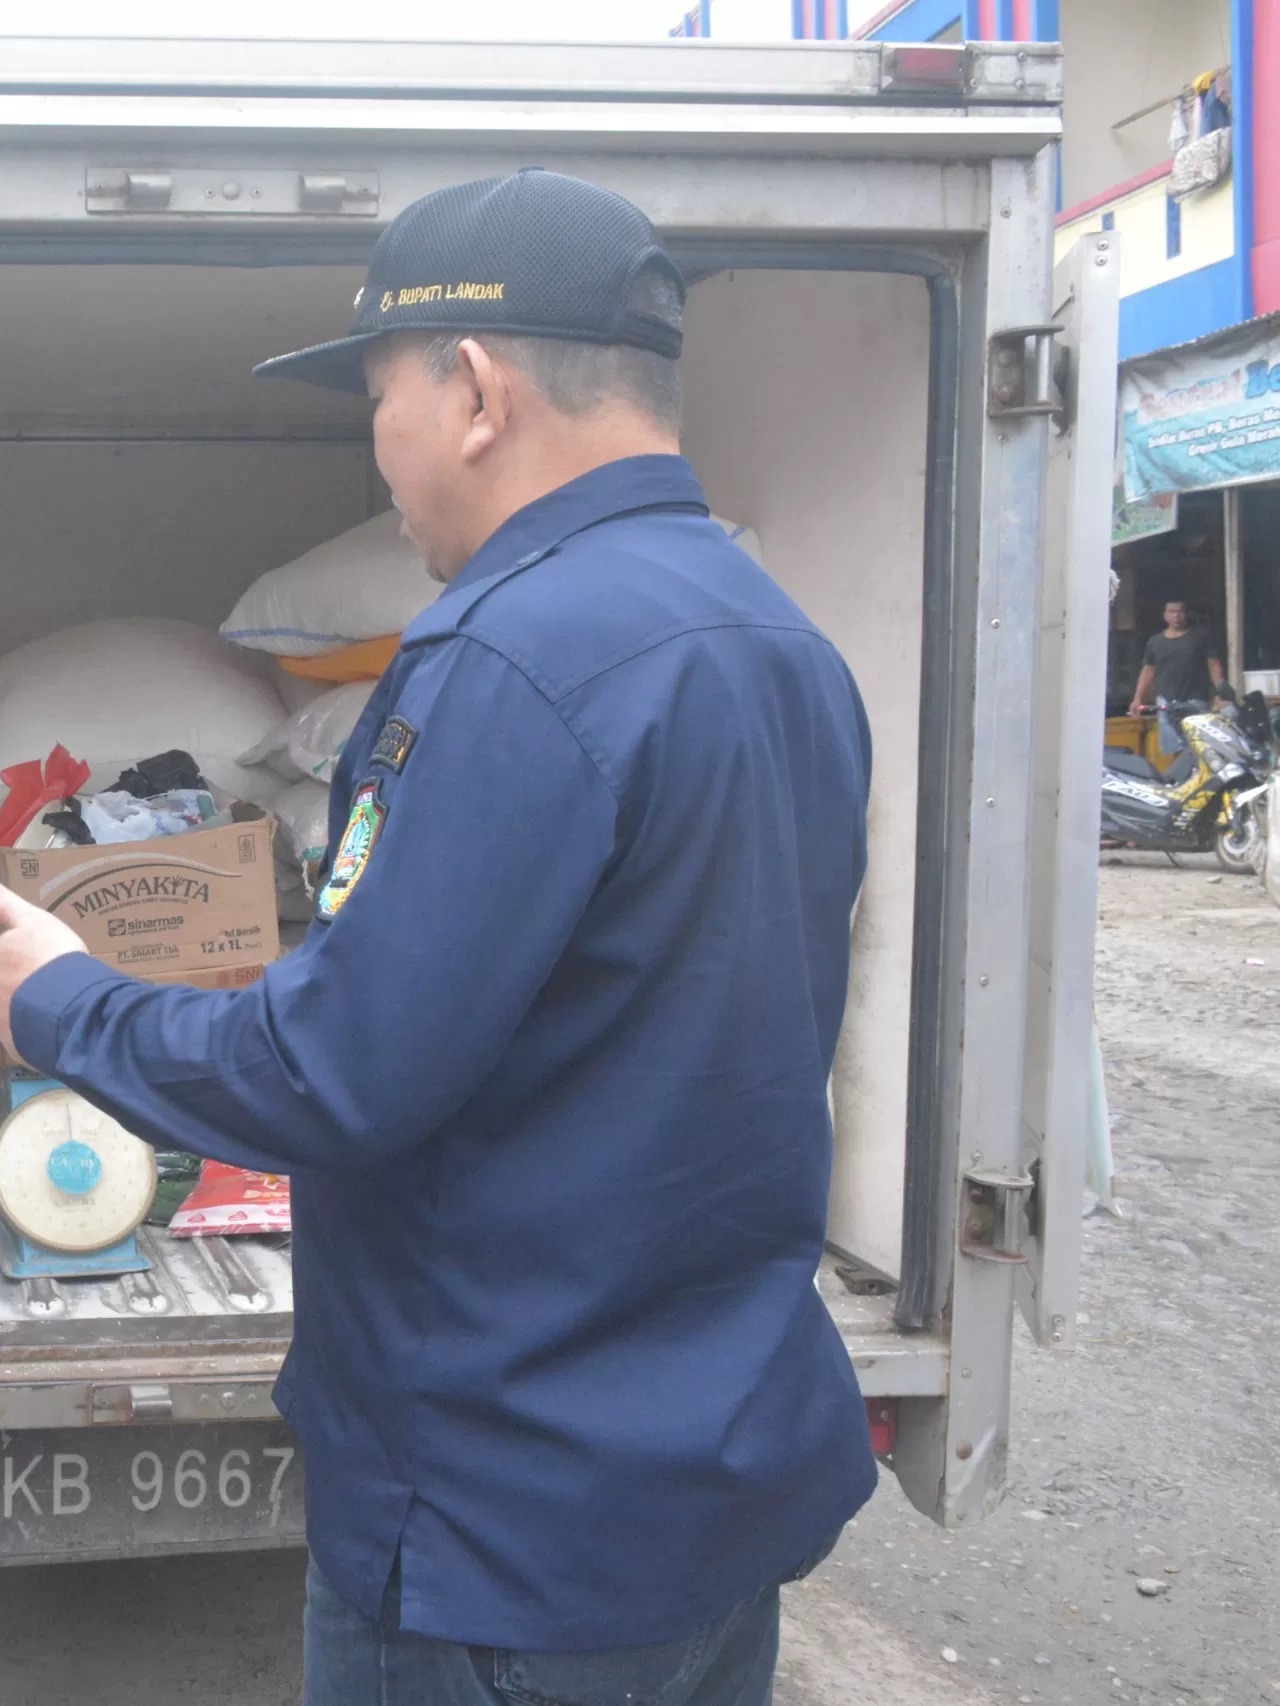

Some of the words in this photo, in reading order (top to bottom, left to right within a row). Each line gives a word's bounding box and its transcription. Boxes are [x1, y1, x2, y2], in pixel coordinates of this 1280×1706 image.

[398, 285, 442, 306] BUPATI
[445, 282, 505, 300] LANDAK
[1229, 414, 1260, 430] Beras
[20, 860, 39, 876] SNI
[71, 873, 210, 919] MINYAKITA
[127, 916, 184, 931] sinarmas
[131, 947, 162, 958] SMART
[200, 941, 215, 954] 12
[3, 1453, 92, 1518] KB
[131, 1448, 295, 1514] 9667
